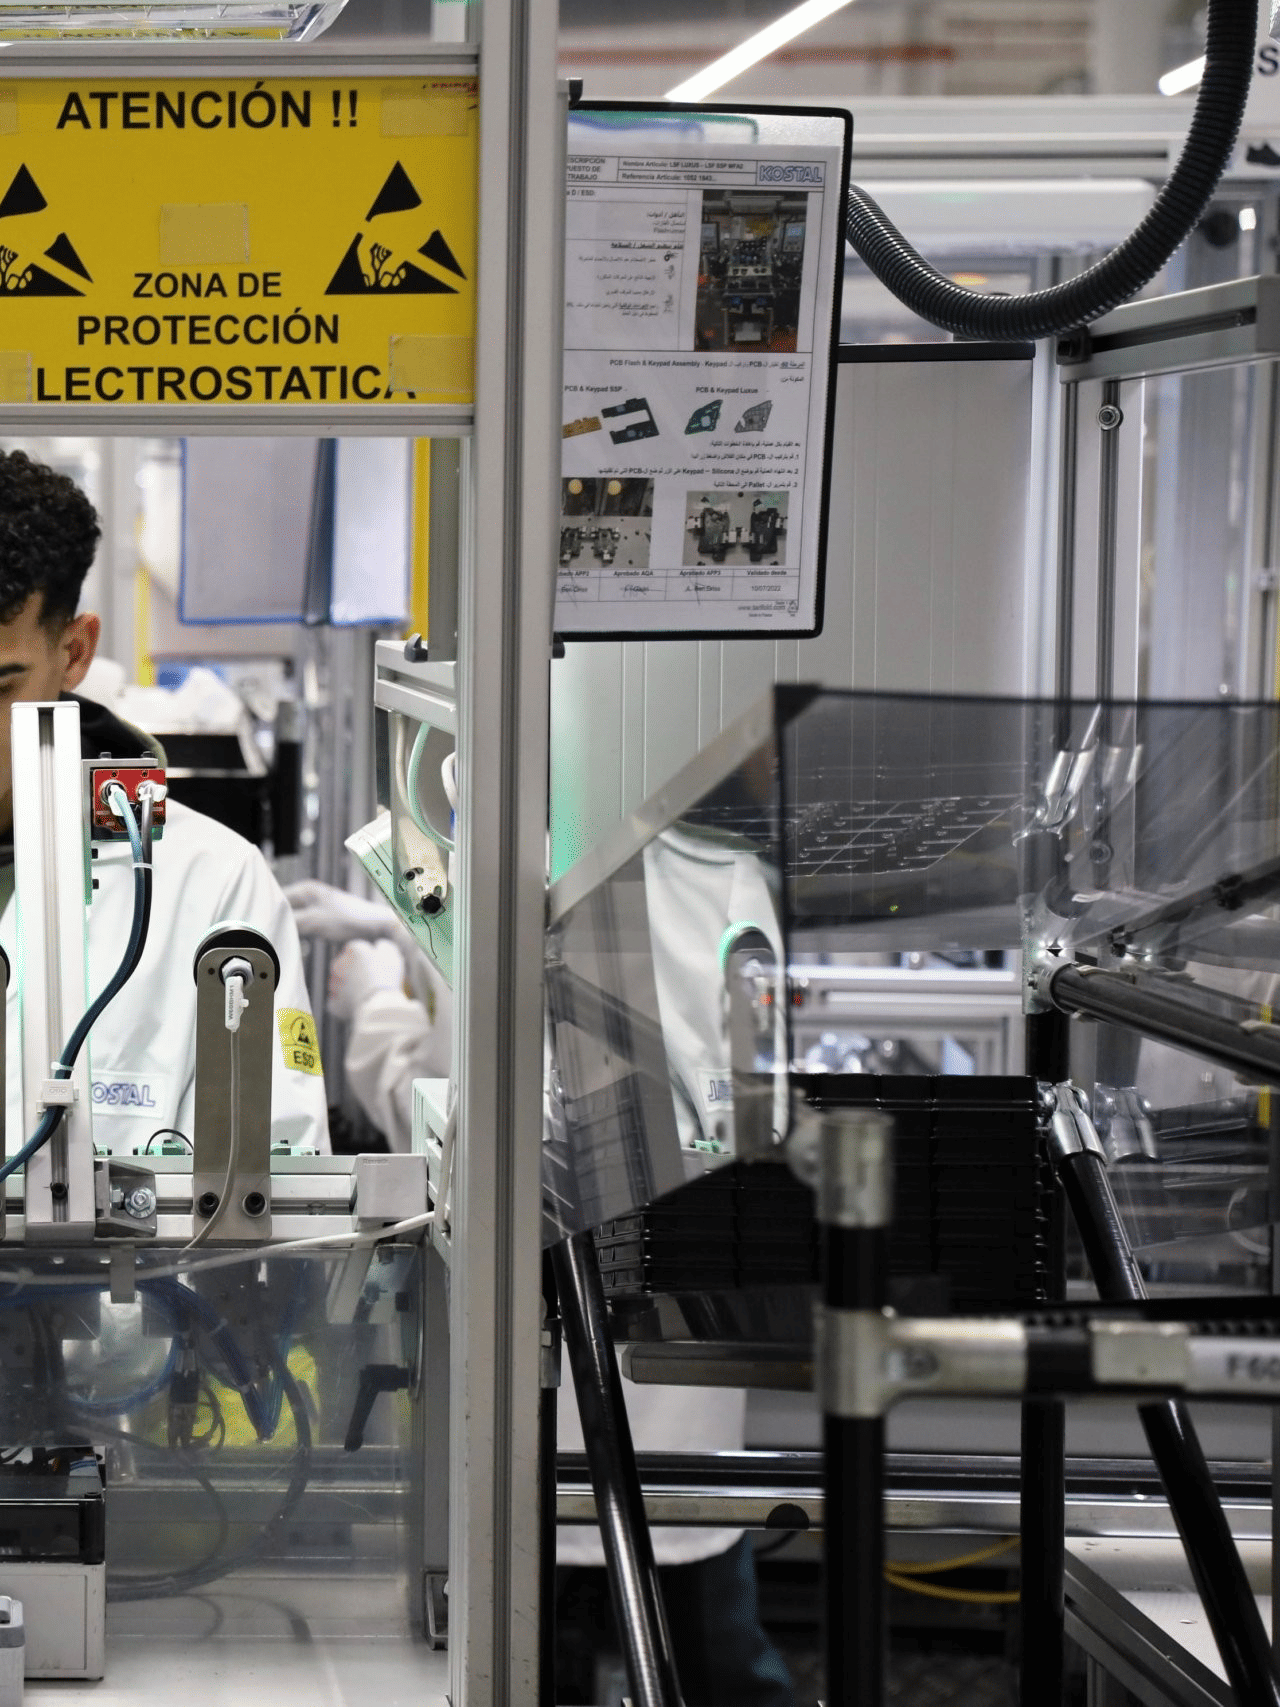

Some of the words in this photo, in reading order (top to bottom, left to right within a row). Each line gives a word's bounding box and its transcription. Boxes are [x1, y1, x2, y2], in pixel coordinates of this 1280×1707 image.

[56, 81, 311, 129] ATENCIÓN
[332, 89, 358, 128] !!
[759, 164, 823, 183] KOSTAL
[133, 272, 228, 298] ZONA
[237, 272, 282, 298] DE
[78, 307, 339, 345] PROTECCIÓN
[648, 360, 671, 368] Keypad
[672, 360, 700, 368] Assembly
[7, 365, 417, 401] LECTROSTATIC
[564, 384, 577, 392] PCB
[586, 385, 608, 394] Keypad
[716, 387, 739, 396] Keypad
[682, 467, 704, 475] Keypad
[748, 480, 765, 488] Pallet
[293, 1050, 315, 1069] ESD
[91, 1081, 156, 1107] OSTAL
